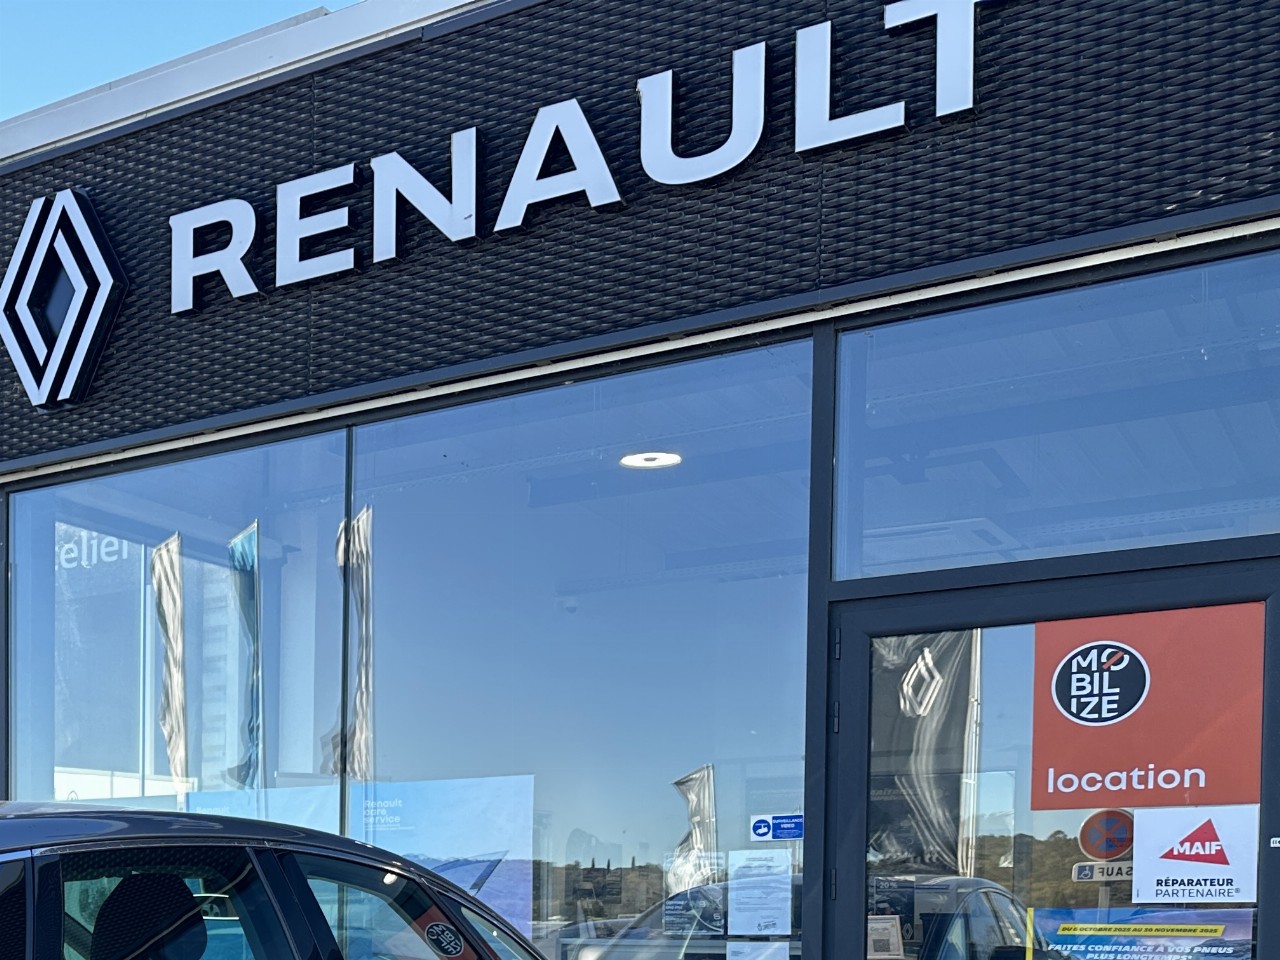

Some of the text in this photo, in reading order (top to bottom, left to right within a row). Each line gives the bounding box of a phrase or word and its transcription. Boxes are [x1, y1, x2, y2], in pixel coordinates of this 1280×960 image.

[168, 0, 978, 314] RENAULT
[1071, 672, 1120, 696] BIL
[1071, 696, 1119, 719] IZE
[1047, 764, 1206, 793] location
[1173, 841, 1221, 855] MAIF
[1156, 877, 1234, 887] RÉPARATEUR
[1087, 944, 1153, 952] CONFIANCE
[1166, 945, 1190, 953] VOS
[1192, 946, 1234, 954] PNEUS
